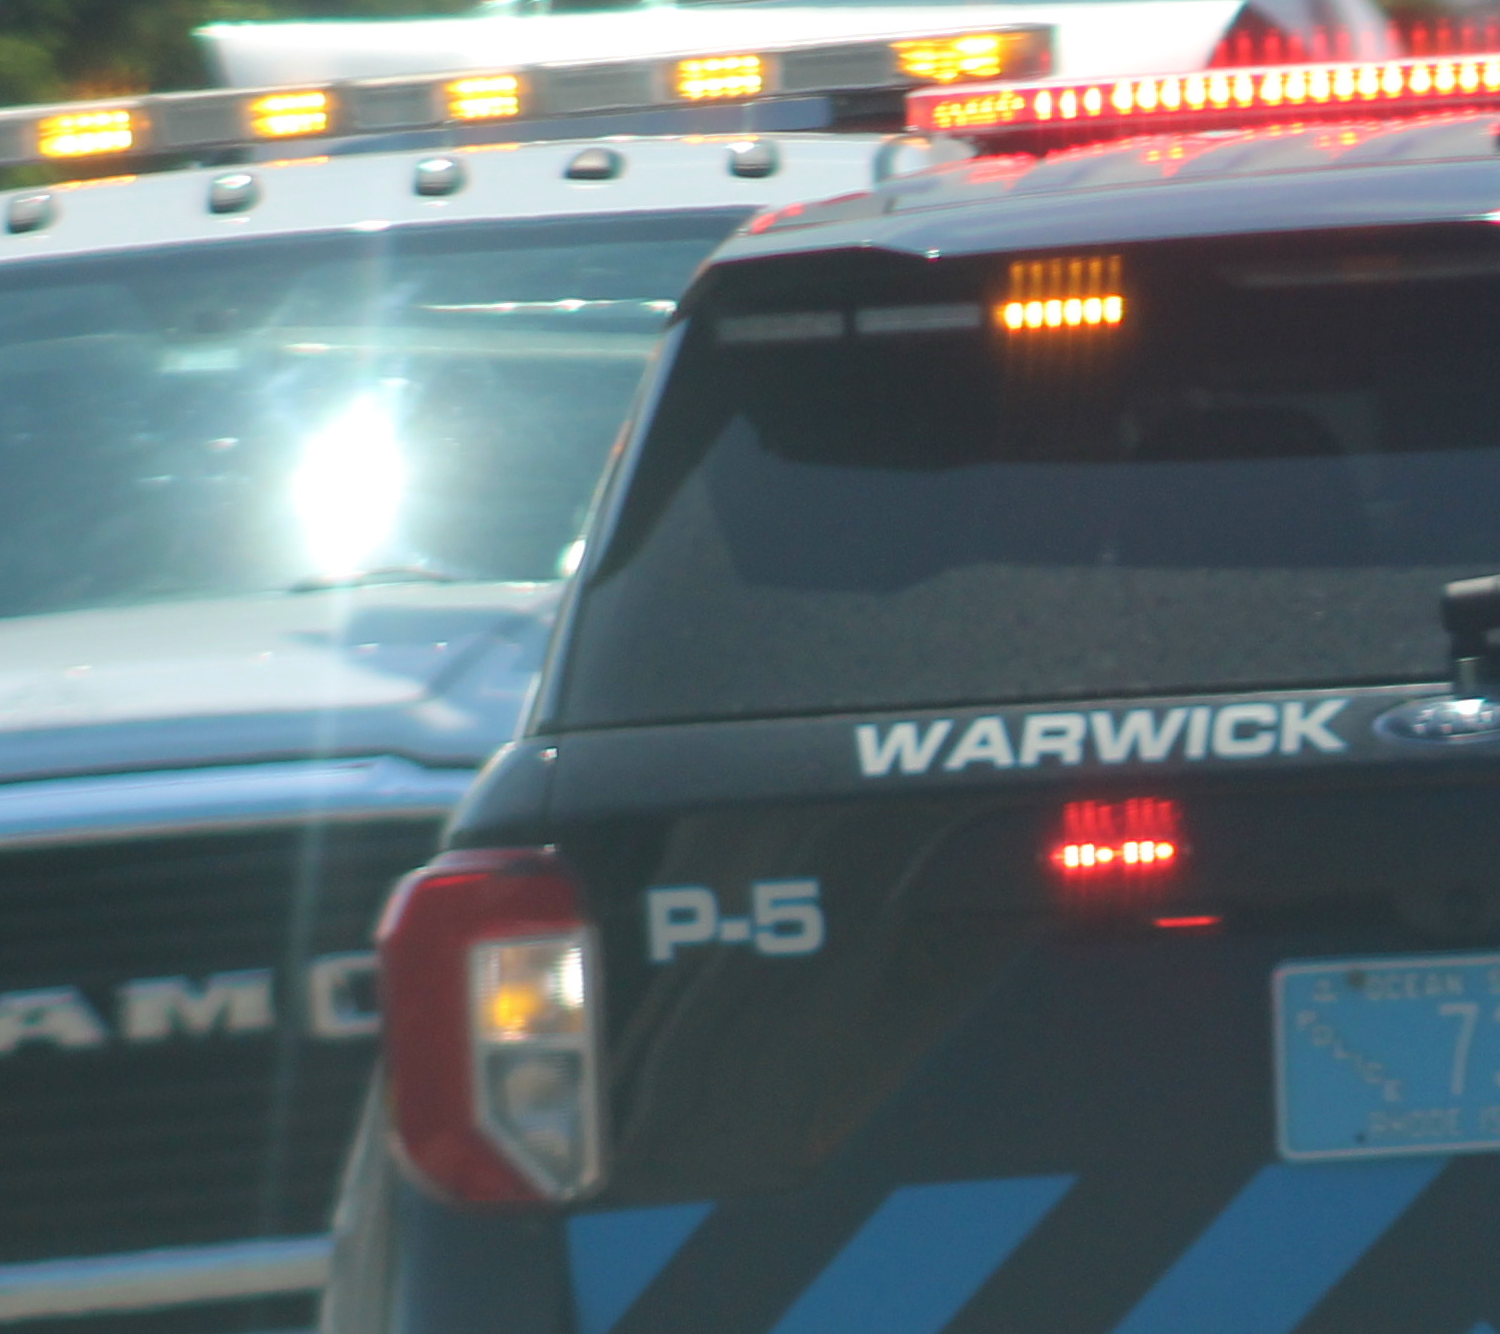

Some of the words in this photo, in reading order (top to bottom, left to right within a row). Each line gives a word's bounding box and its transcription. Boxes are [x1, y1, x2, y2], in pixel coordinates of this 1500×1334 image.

[855, 697, 1350, 778] WARWICK
[647, 877, 824, 965] P-5
[1366, 971, 1465, 1001] OCEAN
